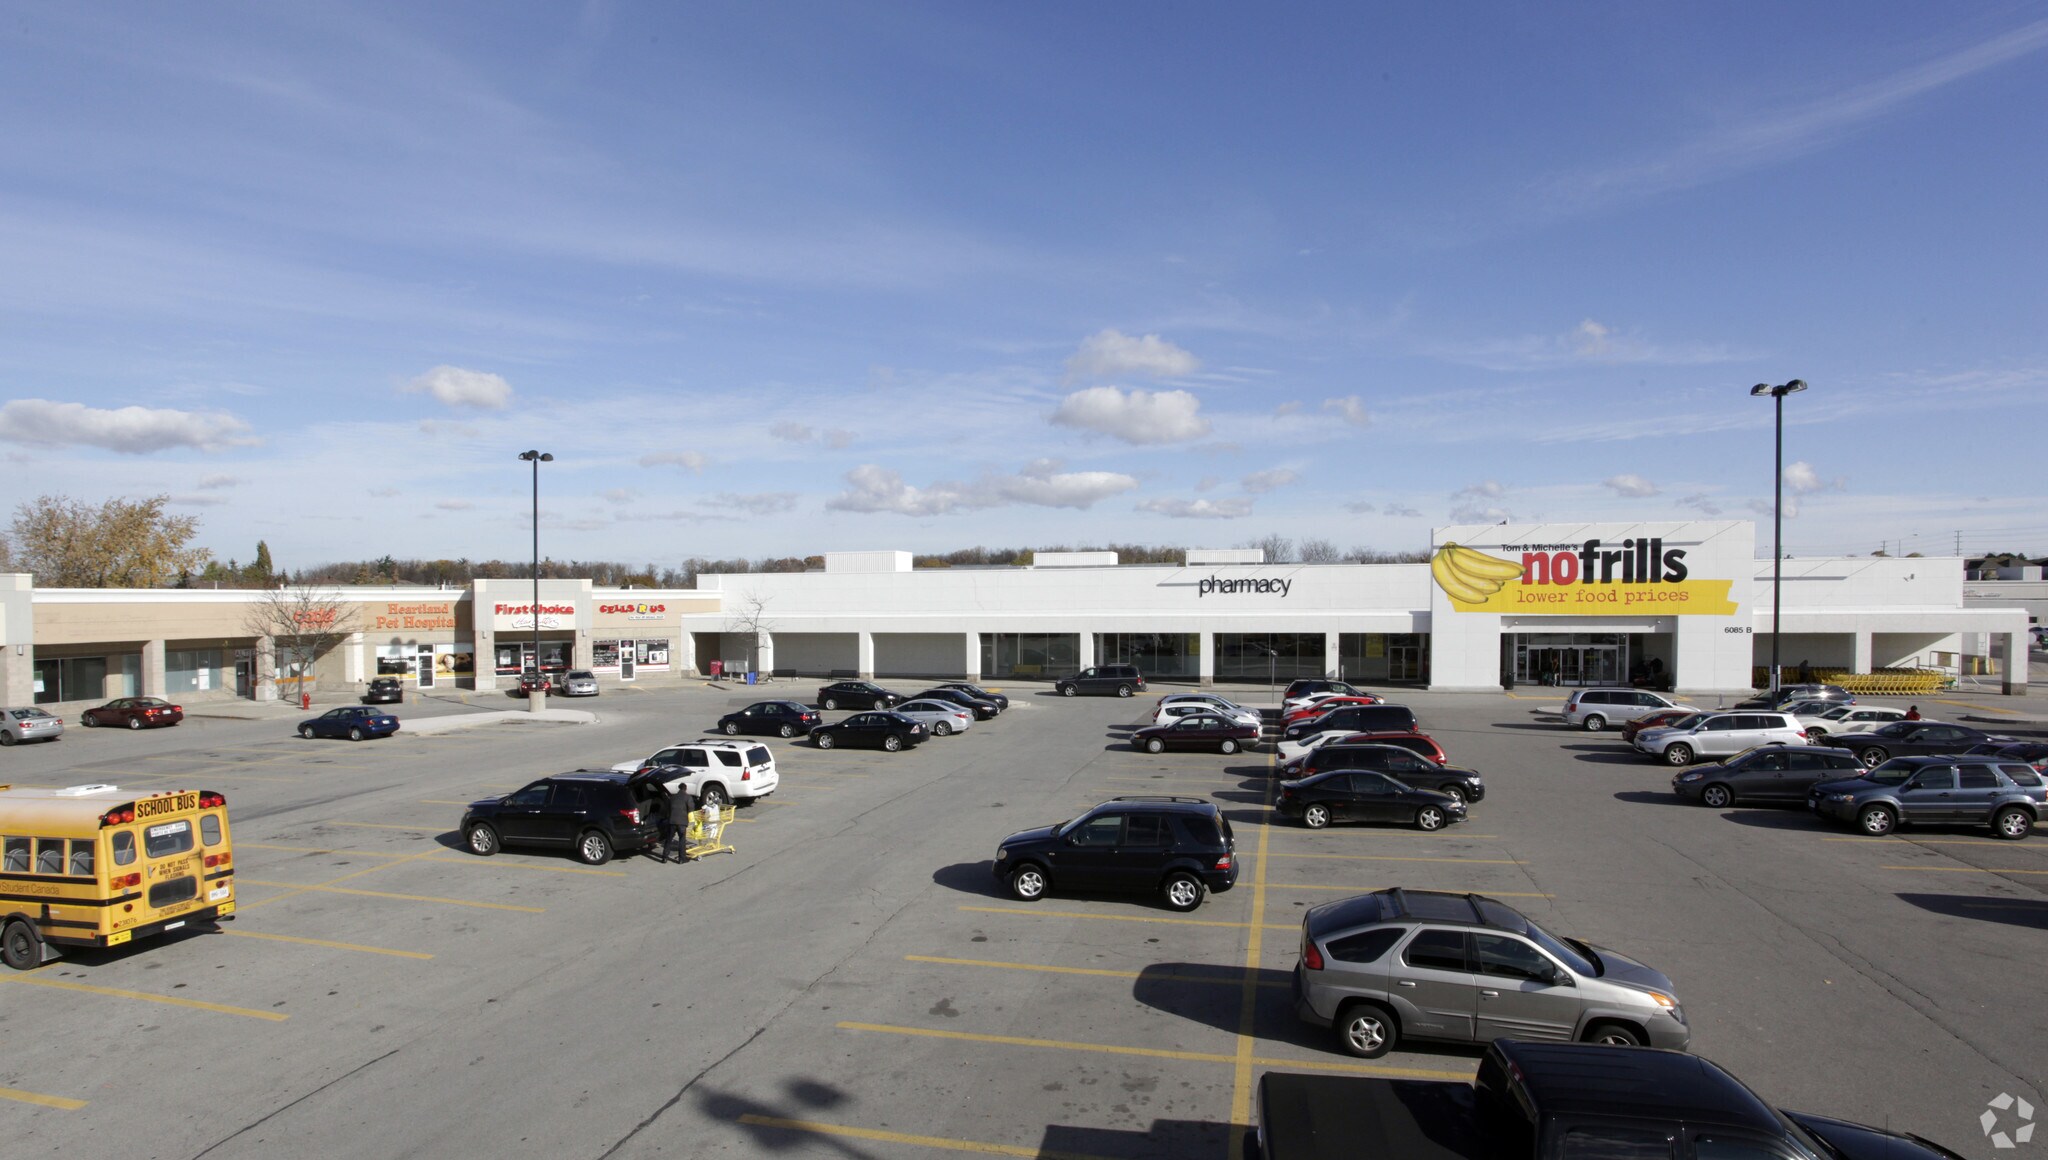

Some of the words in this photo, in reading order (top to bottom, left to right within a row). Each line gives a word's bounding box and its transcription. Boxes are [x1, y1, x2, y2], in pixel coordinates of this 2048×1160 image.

[1501, 543, 1521, 552] Tom
[1522, 543, 1530, 552] &
[1532, 543, 1578, 552] Michelle's
[1199, 574, 1292, 598] pharmacy
[1516, 590, 1568, 603] lower
[1575, 589, 1618, 603] food
[1624, 589, 1689, 605] prices
[387, 603, 449, 615] Heartland
[495, 604, 530, 615] First
[530, 604, 575, 615] Choice
[637, 604, 648, 614] R
[649, 604, 666, 613] US
[376, 616, 400, 629] Pet
[403, 615, 459, 631] Hospital
[1724, 626, 1744, 634] 6085
[1746, 626, 1753, 634] B
[137, 797, 175, 818] SCHOOL
[177, 794, 196, 811] BUS
[173, 864, 190, 872] SIGNALS
[165, 871, 185, 879] FLASHING
[1, 881, 30, 893] Student
[30, 883, 60, 895] Canada
